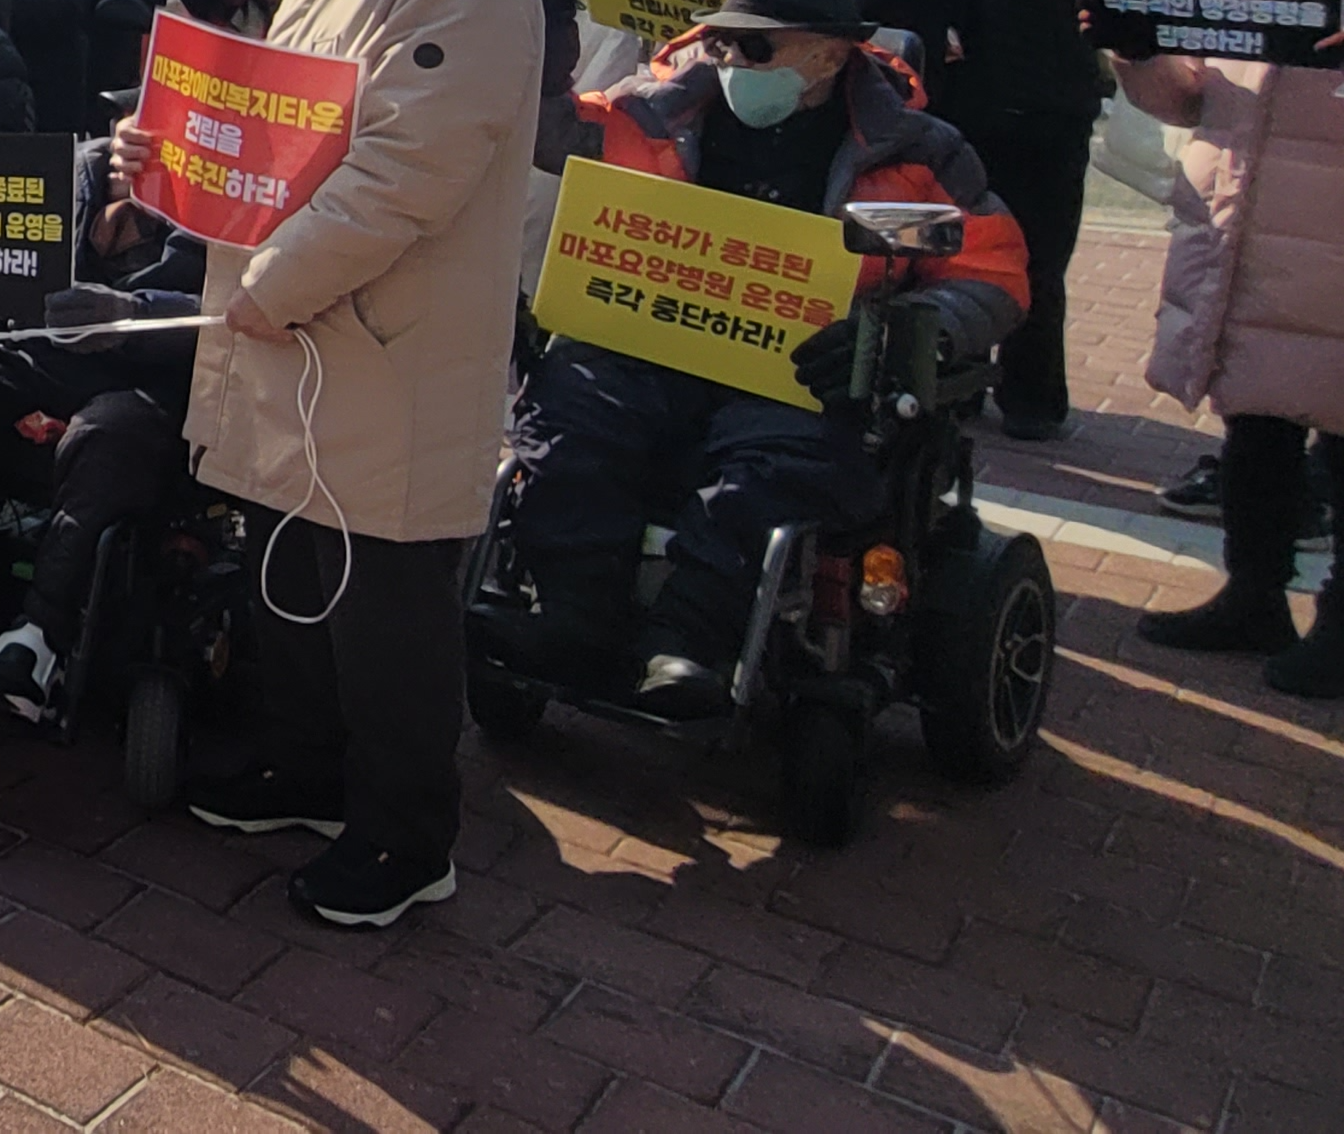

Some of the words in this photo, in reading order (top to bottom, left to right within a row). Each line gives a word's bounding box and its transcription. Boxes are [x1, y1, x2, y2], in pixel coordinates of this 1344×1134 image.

[1156, 24, 1264, 54] 집행하라!
[152, 54, 345, 135] 마포장애인복지타운
[184, 109, 243, 158] 건립을
[159, 138, 187, 178] 즉각
[184, 153, 290, 210] 추진하라
[5, 212, 63, 242] 운영을
[593, 204, 714, 257] 사용허가
[719, 236, 815, 284] 종료된
[558, 232, 735, 302] 마포요양병원
[740, 281, 836, 330] 운영을
[585, 275, 646, 313] 즉각
[650, 293, 787, 354] 중단하라!
